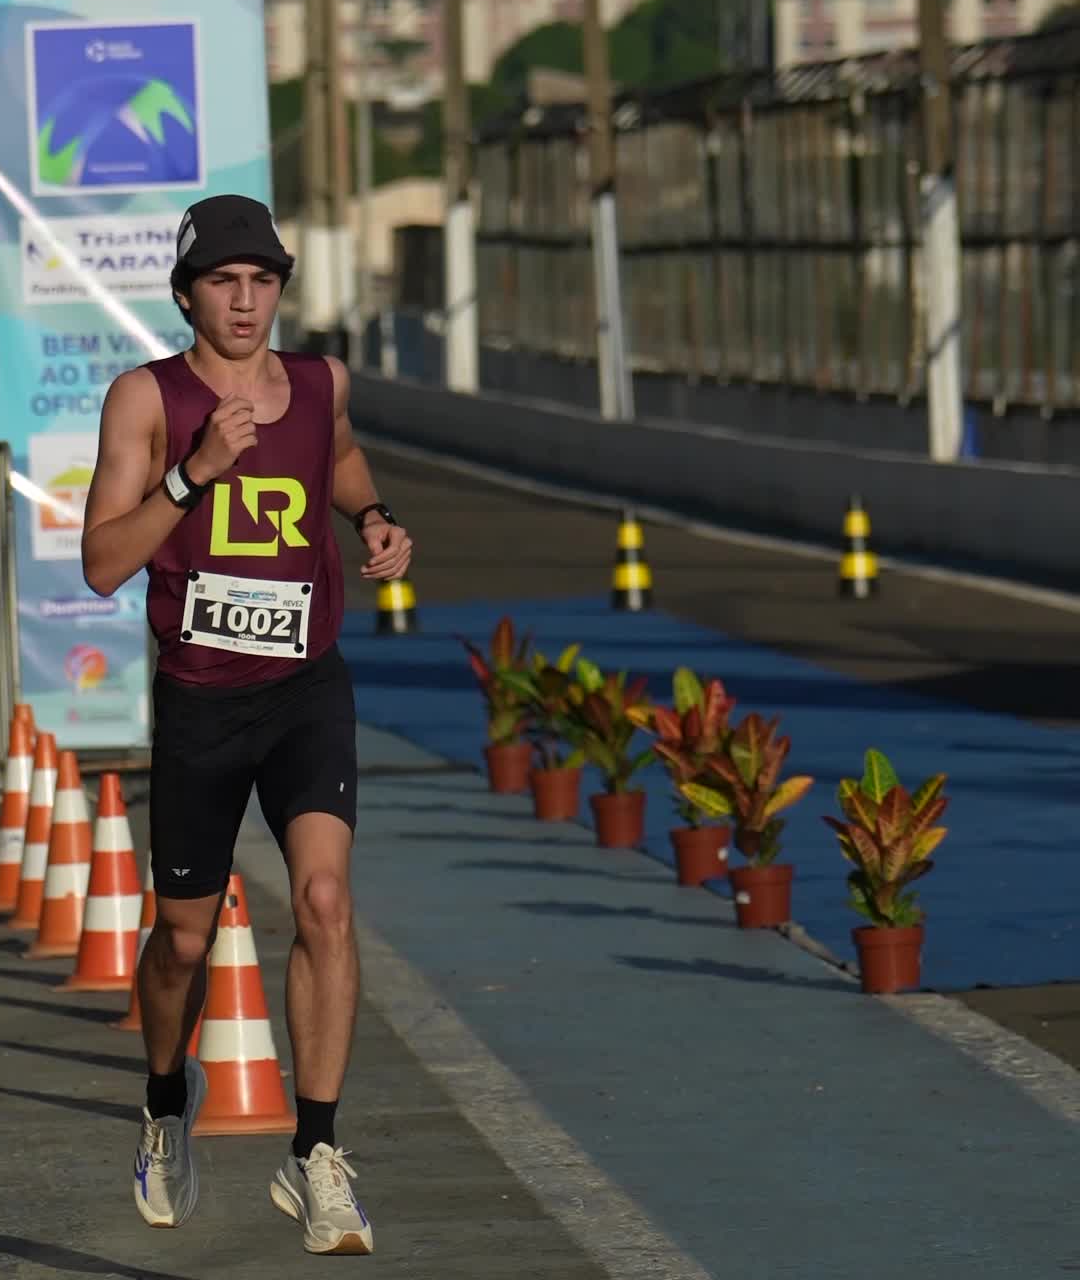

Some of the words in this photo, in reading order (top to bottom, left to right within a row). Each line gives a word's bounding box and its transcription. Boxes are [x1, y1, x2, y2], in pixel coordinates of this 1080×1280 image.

[78, 229, 177, 246] Triathl
[43, 334, 100, 357] BEM
[40, 363, 80, 385] AO
[210, 475, 310, 557] LR
[206, 602, 293, 637] 1002
